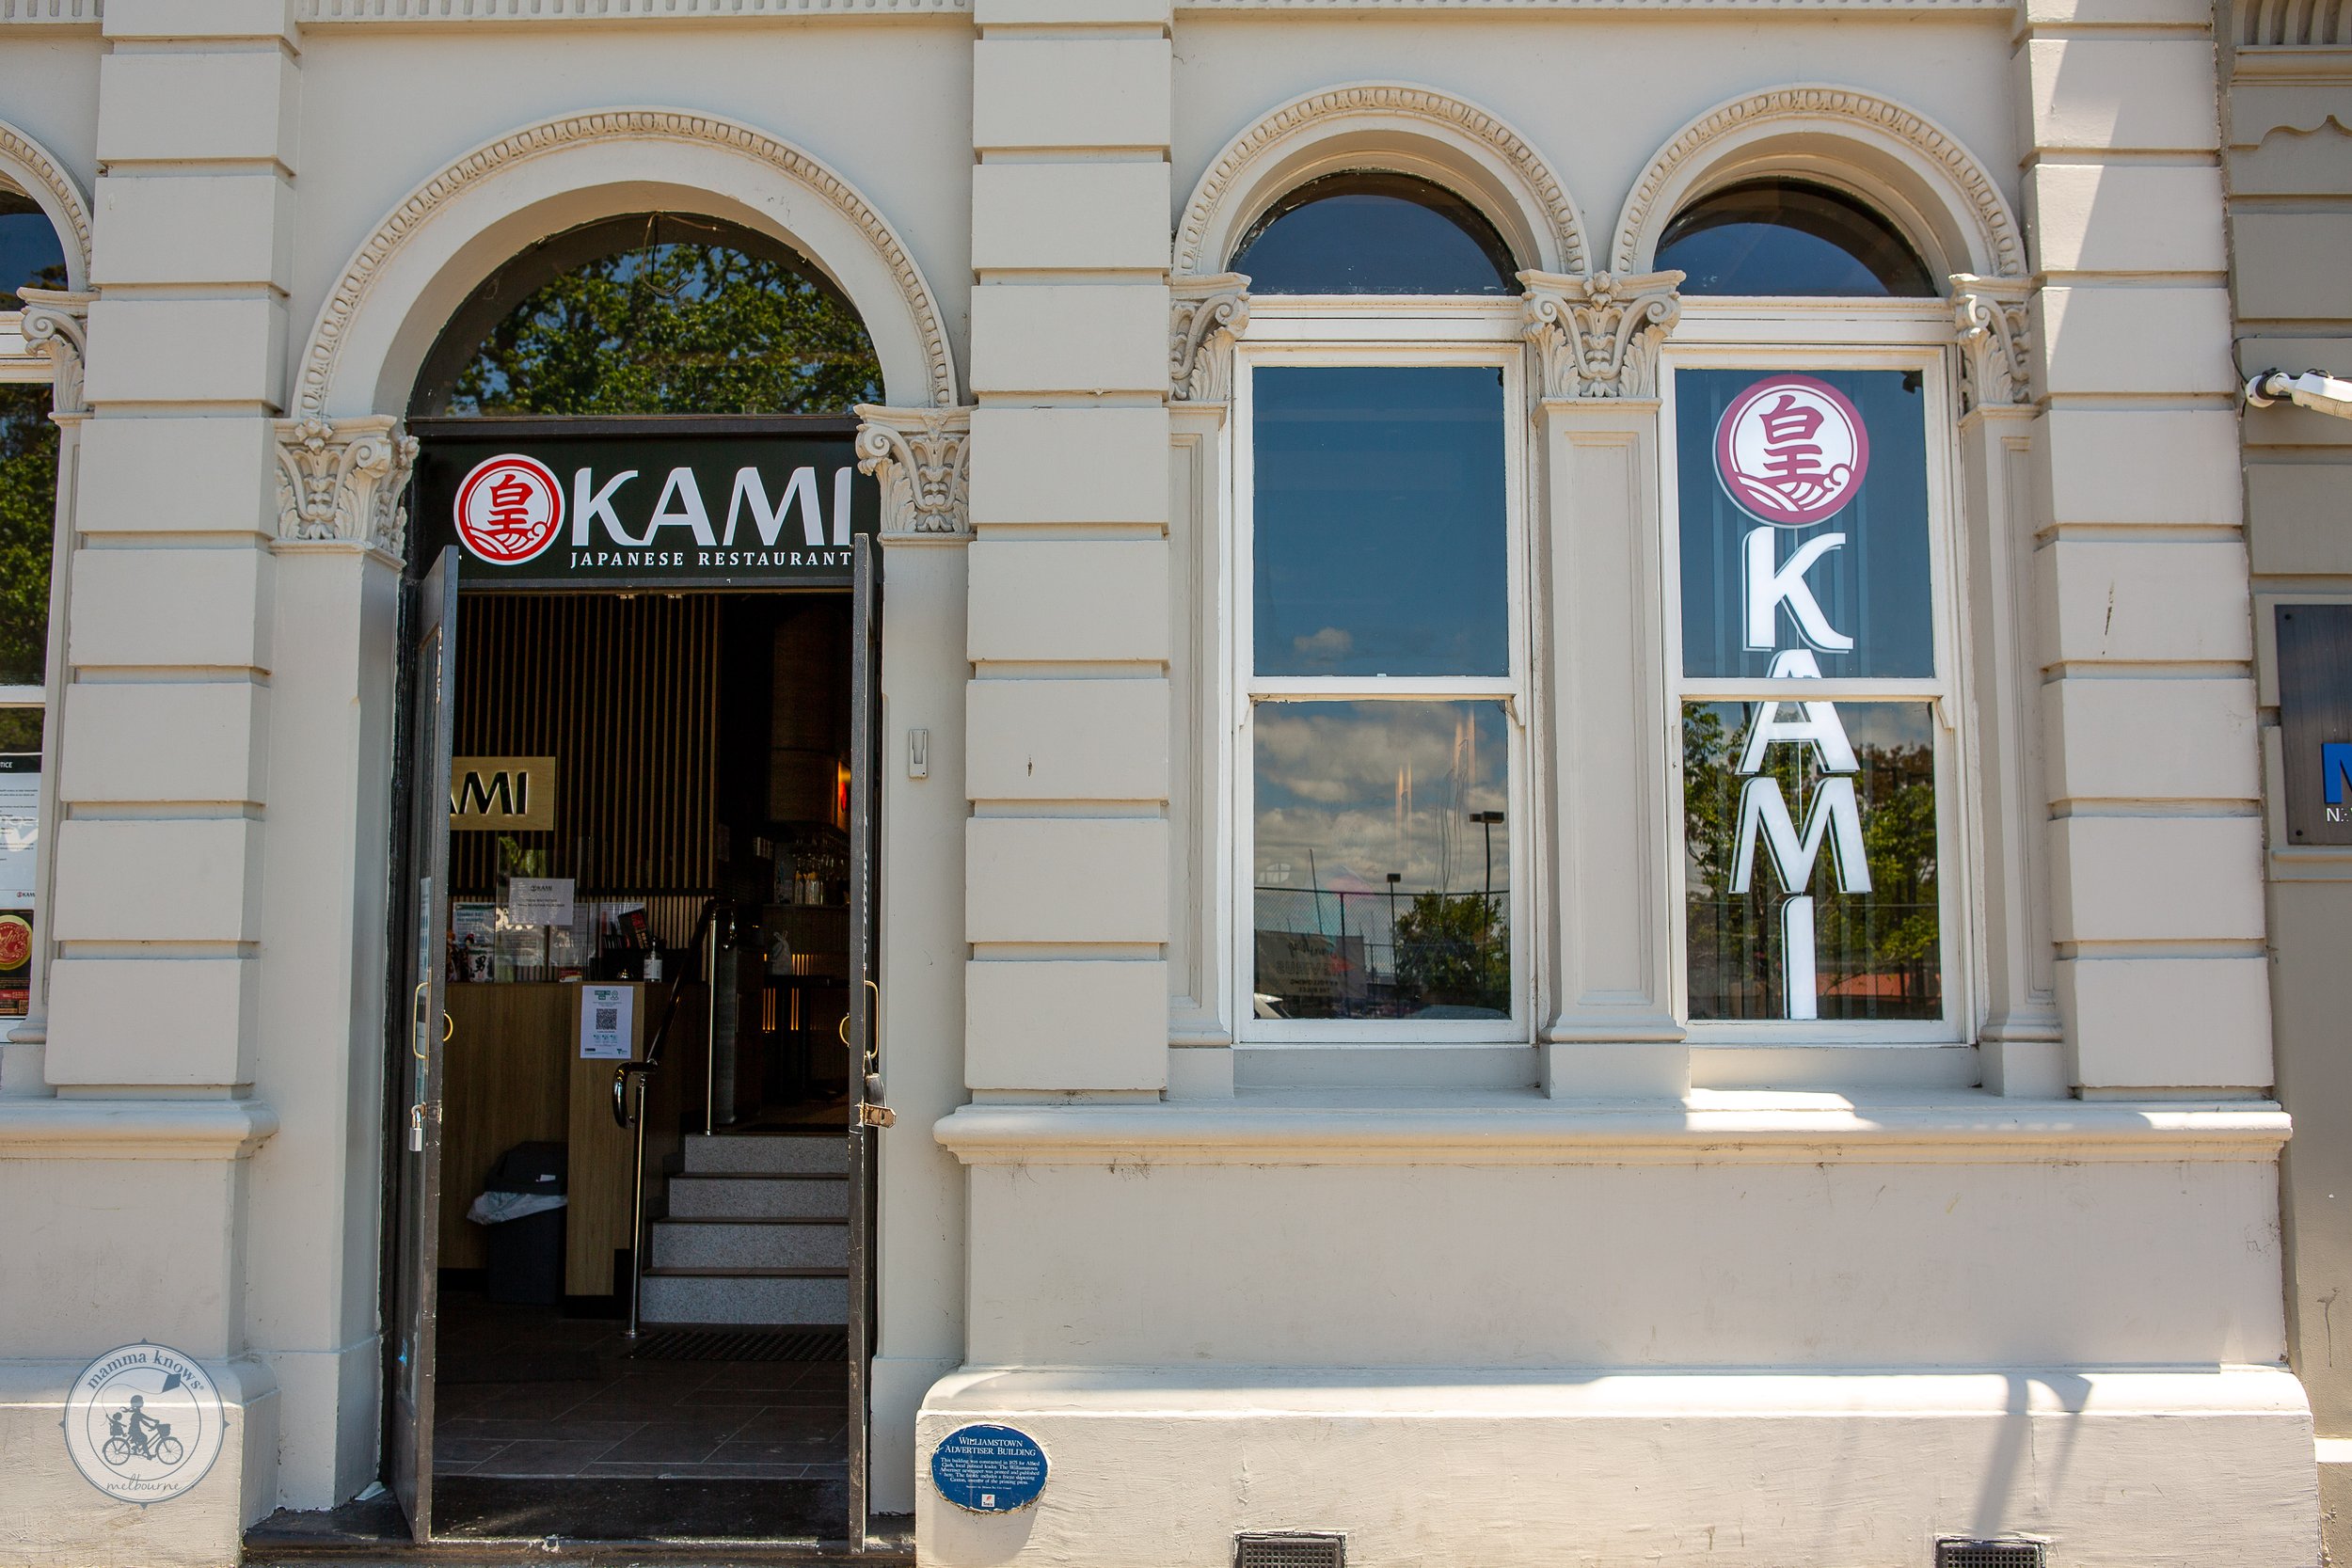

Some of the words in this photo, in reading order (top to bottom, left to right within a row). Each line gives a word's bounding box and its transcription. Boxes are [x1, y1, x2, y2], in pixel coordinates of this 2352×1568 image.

[571, 467, 852, 546] KAMI
[570, 552, 684, 569] JAPANESE
[699, 552, 852, 566] RESTAURANT
[945, 1445, 994, 1455] ADVERTISER
[997, 1447, 1036, 1457] BUILDING
